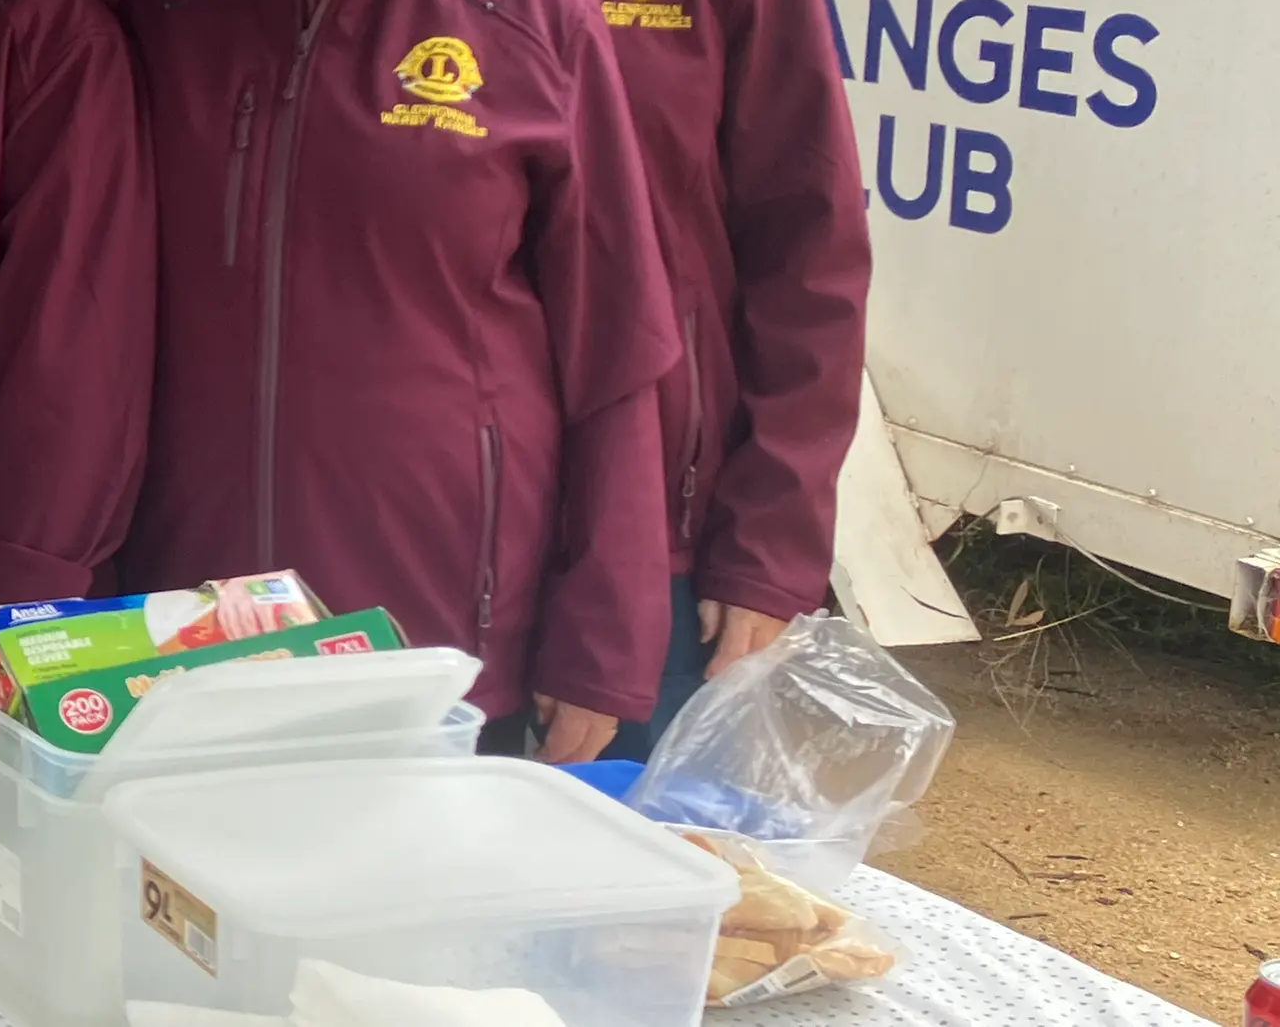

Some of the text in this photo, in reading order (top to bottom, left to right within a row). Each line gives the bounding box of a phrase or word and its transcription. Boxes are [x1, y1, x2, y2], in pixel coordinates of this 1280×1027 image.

[426, 55, 455, 83] L
[864, 114, 1014, 235] UB
[11, 603, 60, 621] Ansell
[63, 694, 104, 718] 200
[70, 711, 106, 728] PACK
[145, 880, 173, 922] 9L
